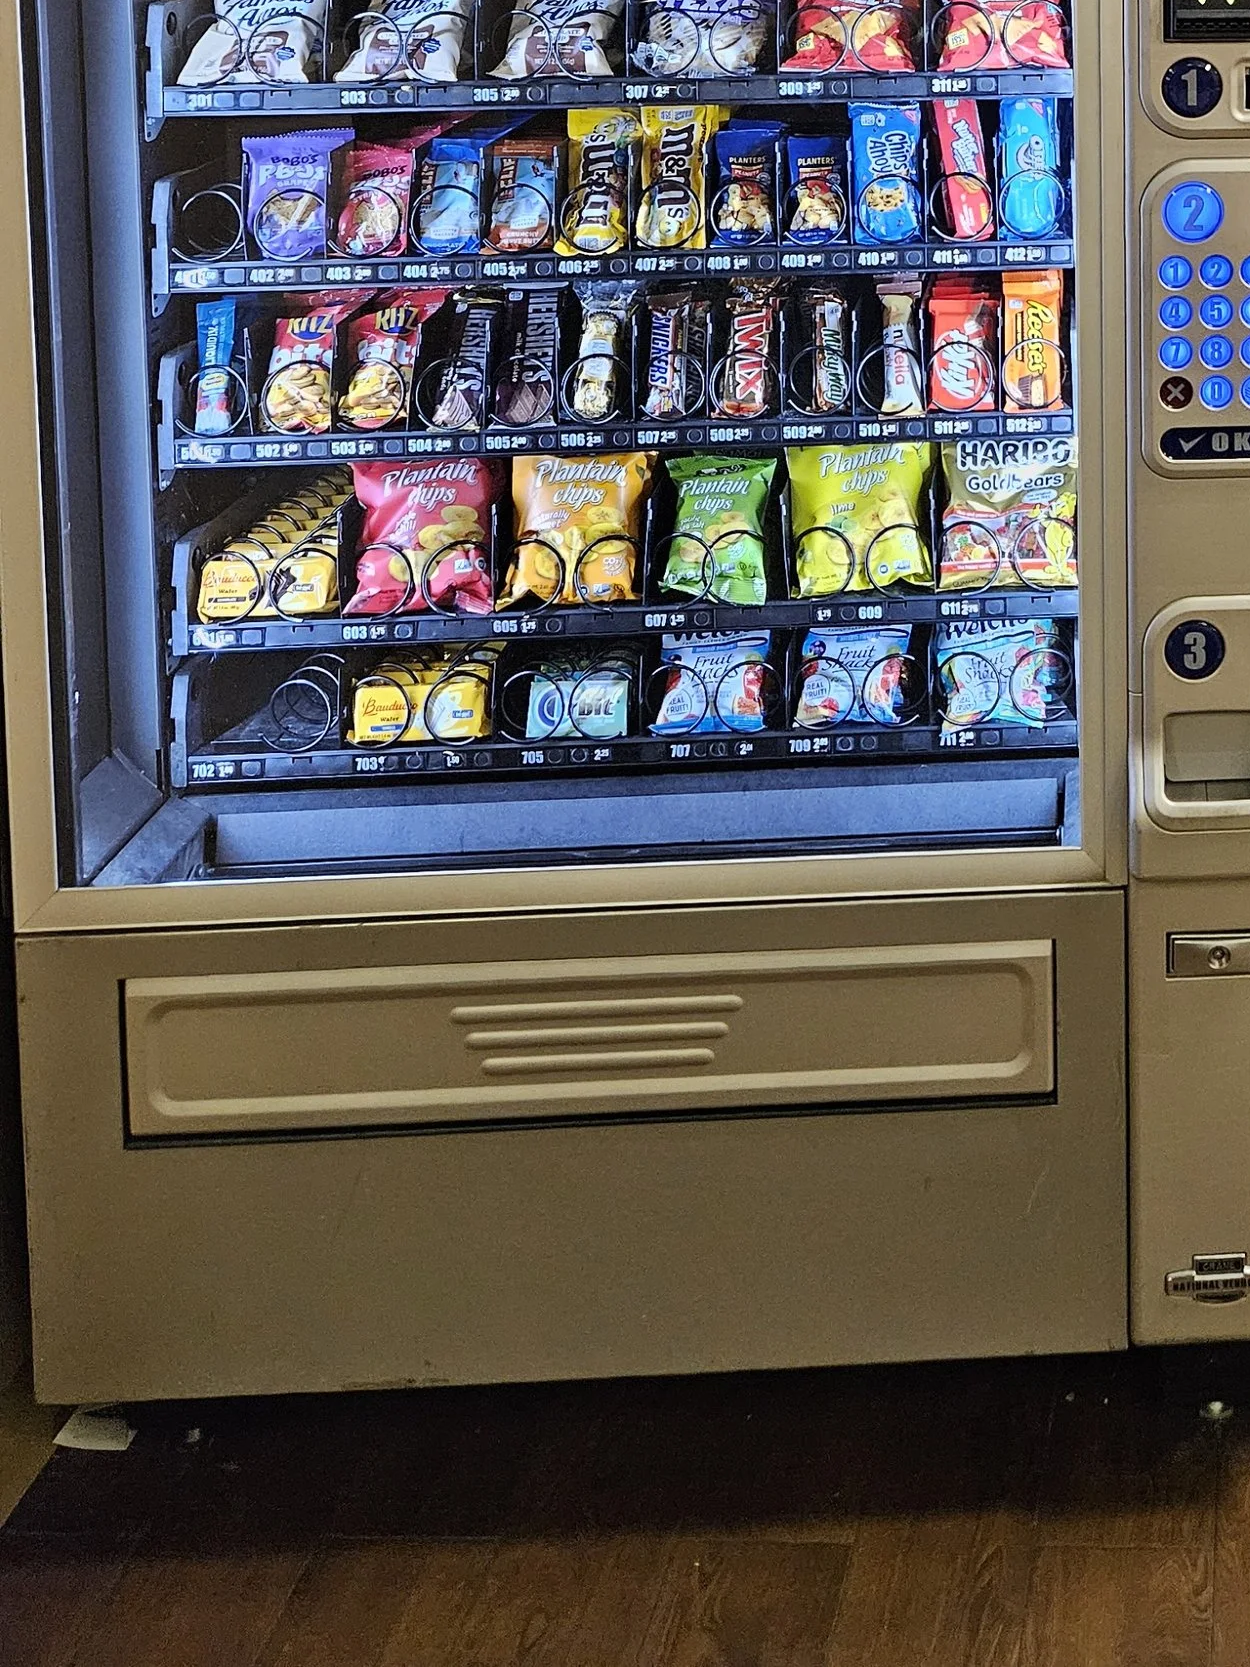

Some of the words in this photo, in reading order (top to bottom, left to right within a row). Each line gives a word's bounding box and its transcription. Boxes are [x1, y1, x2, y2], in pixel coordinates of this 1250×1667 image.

[1181, 69, 1198, 107] 1
[271, 154, 318, 166] BOBO'S
[729, 155, 767, 165] PLANTERS
[797, 157, 836, 166] PLANTERS
[884, 133, 907, 174] Chips
[1182, 194, 1205, 232] 2
[1170, 262, 1180, 282] 1
[1210, 262, 1222, 281] 2
[1169, 303, 1181, 322] 4
[1210, 301, 1222, 322] 5
[521, 291, 559, 383] HERSHEY'S
[1027, 299, 1055, 377] Reese's
[650, 312, 673, 386] SNICKERS
[733, 308, 772, 403] TWIX
[1170, 343, 1181, 363] 7
[1210, 341, 1222, 362] 8
[1211, 382, 1221, 401] 0
[818, 443, 906, 480] Plantain
[957, 440, 1073, 467] HARIBO
[535, 459, 629, 490] Plantain
[552, 483, 605, 513] chips
[678, 477, 753, 499] Plantain
[693, 496, 734, 513] chips
[692, 653, 734, 670] Fruit
[836, 645, 877, 660] Fruit
[1183, 632, 1206, 670] 3
[1172, 1279, 1221, 1291] NATIONAL
